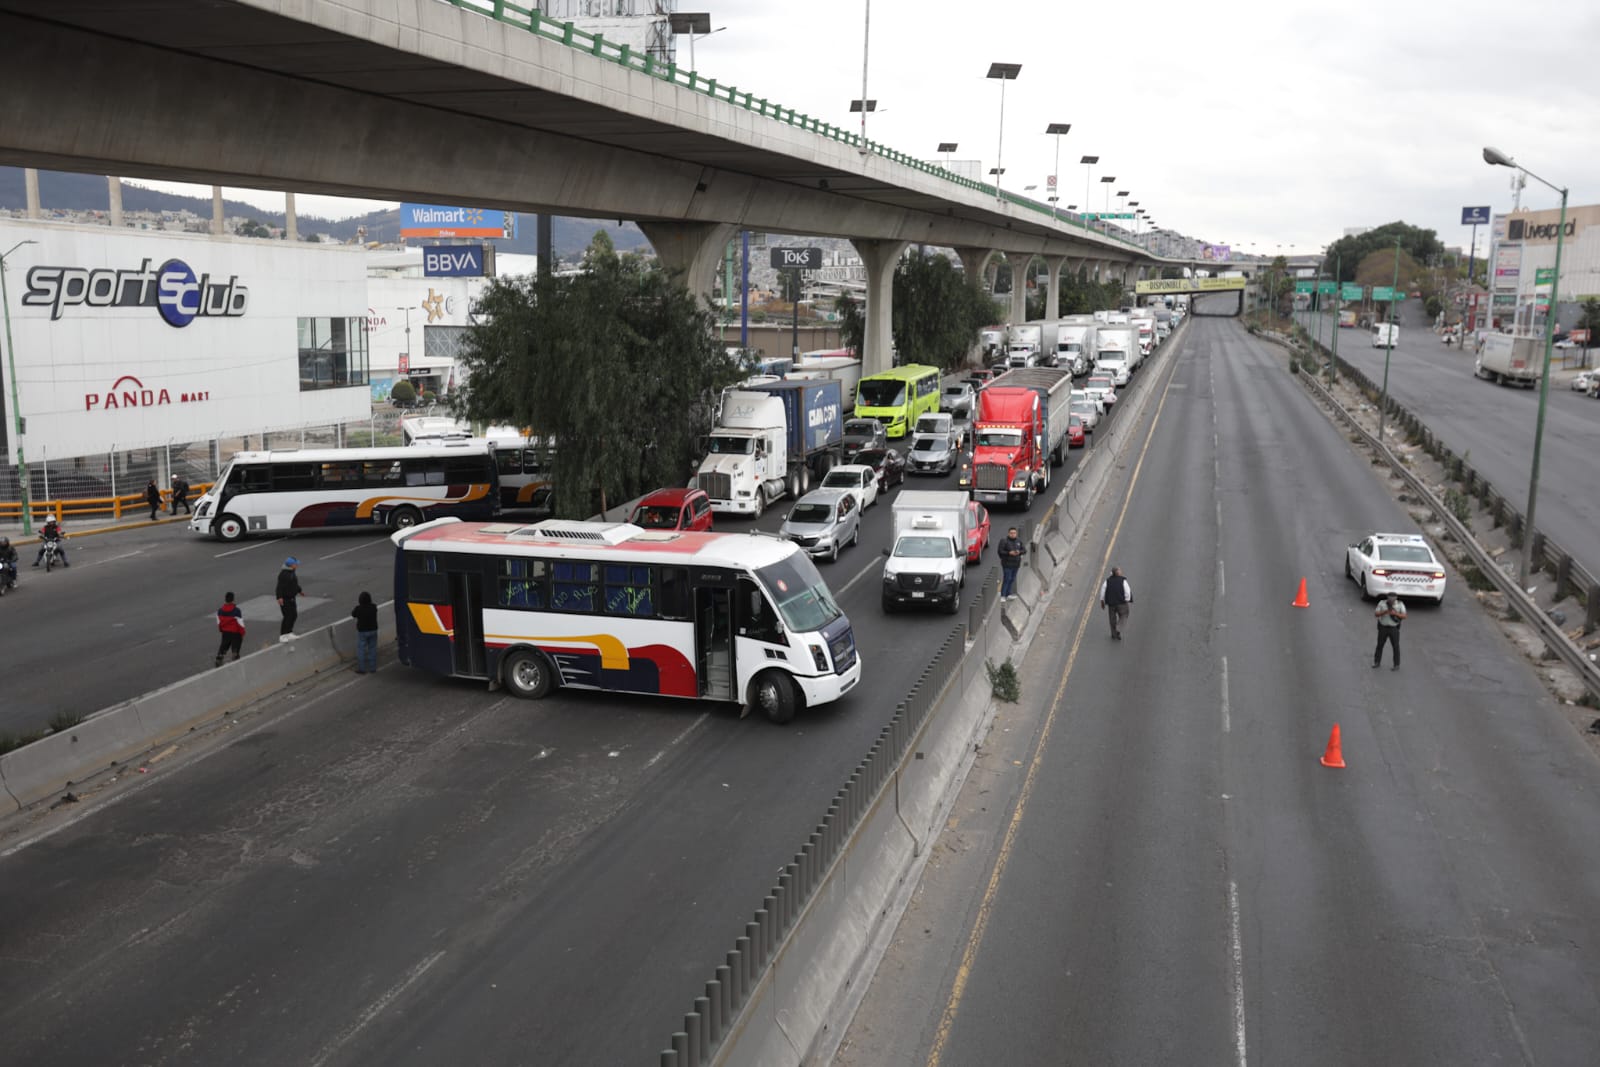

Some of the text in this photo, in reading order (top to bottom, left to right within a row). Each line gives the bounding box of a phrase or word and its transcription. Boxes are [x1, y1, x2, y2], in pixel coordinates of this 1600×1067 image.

[412, 207, 465, 223] Walmart
[1524, 218, 1576, 240] Liverpol
[427, 251, 477, 272] BBVA
[1149, 280, 1181, 290] DISPONIBLE
[85, 388, 210, 411] PANDA MART
